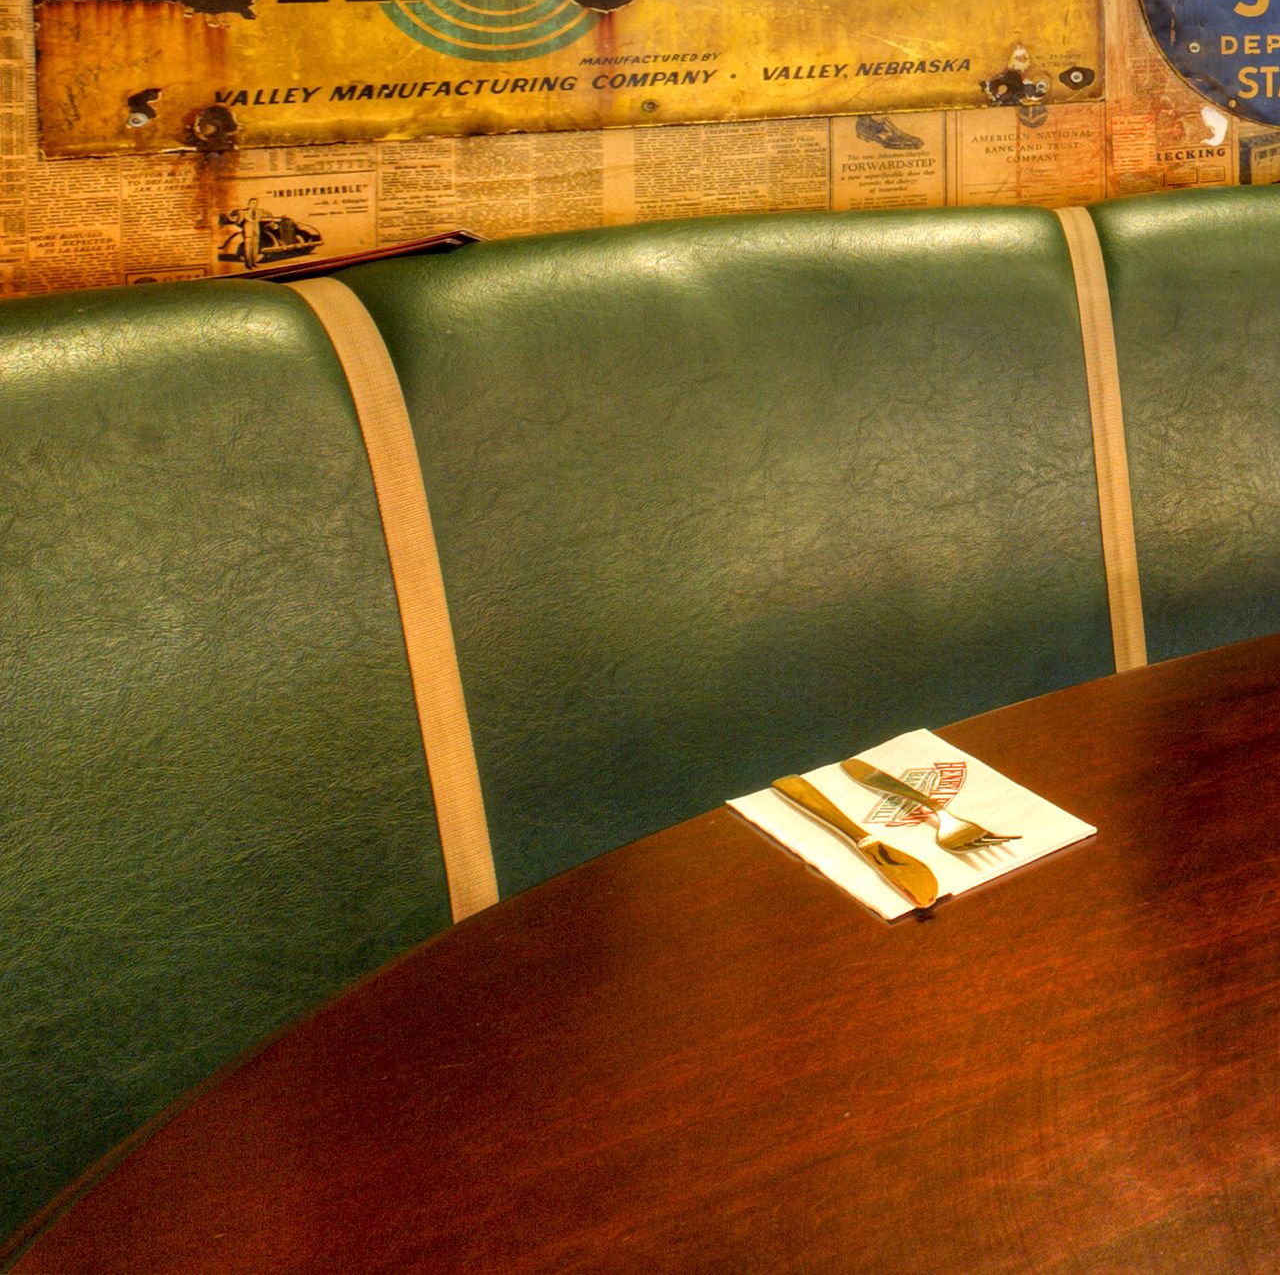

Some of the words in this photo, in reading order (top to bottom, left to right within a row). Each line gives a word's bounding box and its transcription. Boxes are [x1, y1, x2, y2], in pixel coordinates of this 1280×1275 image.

[580, 52, 699, 66] MANUFACTURED
[700, 52, 722, 63] BY
[213, 86, 322, 108] VALLEY
[330, 74, 578, 102] MANUFACTURING
[592, 68, 720, 92] COMPANY
[762, 63, 849, 82] VALLEY,
[855, 57, 973, 77] NEBRASKA
[971, 132, 1031, 144] AMERICAN
[1037, 130, 1094, 141] NATIONAL
[984, 145, 1012, 155] BANK
[1020, 142, 1043, 152] AND
[1047, 141, 1080, 151] TRUST
[1006, 152, 1059, 164] COMPANY
[841, 158, 936, 173] FORWARD-STEP
